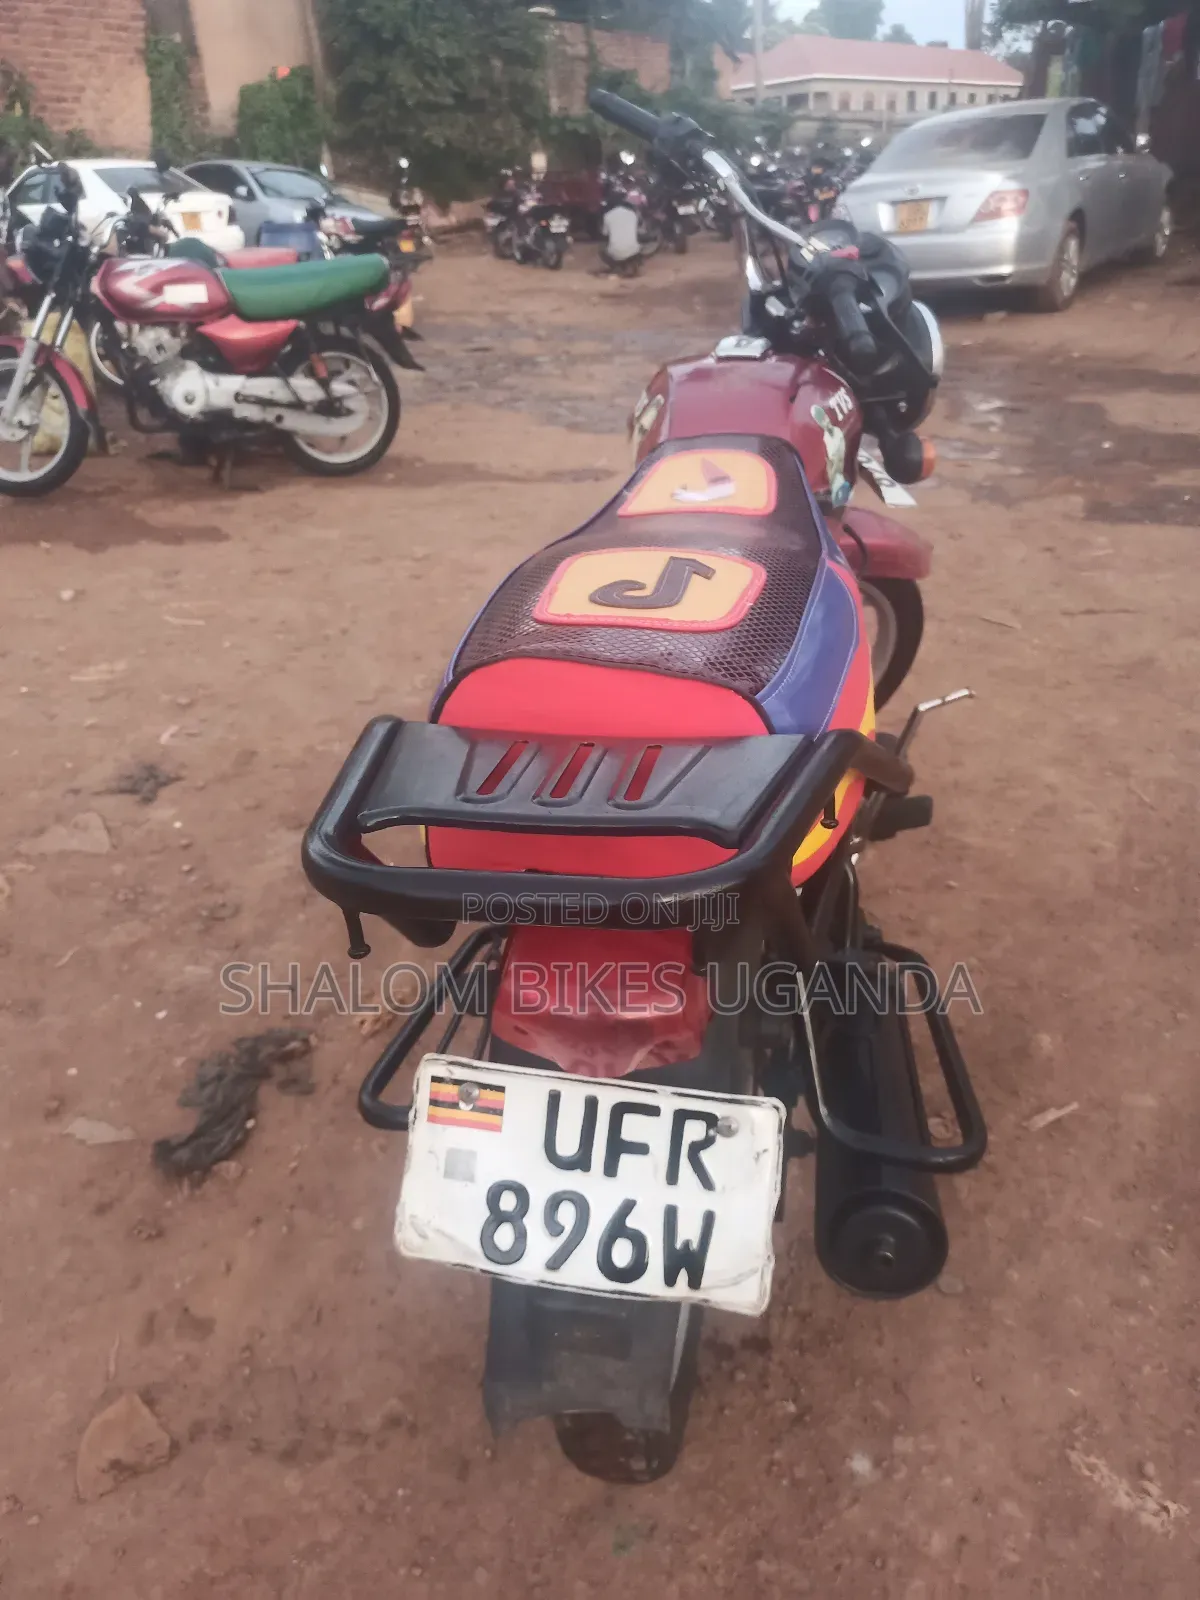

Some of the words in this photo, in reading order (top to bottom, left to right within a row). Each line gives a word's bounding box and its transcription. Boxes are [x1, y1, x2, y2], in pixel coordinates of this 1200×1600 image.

[828, 386, 854, 421] TVS
[544, 1089, 720, 1191] UFR
[480, 1179, 716, 1290] 896W
